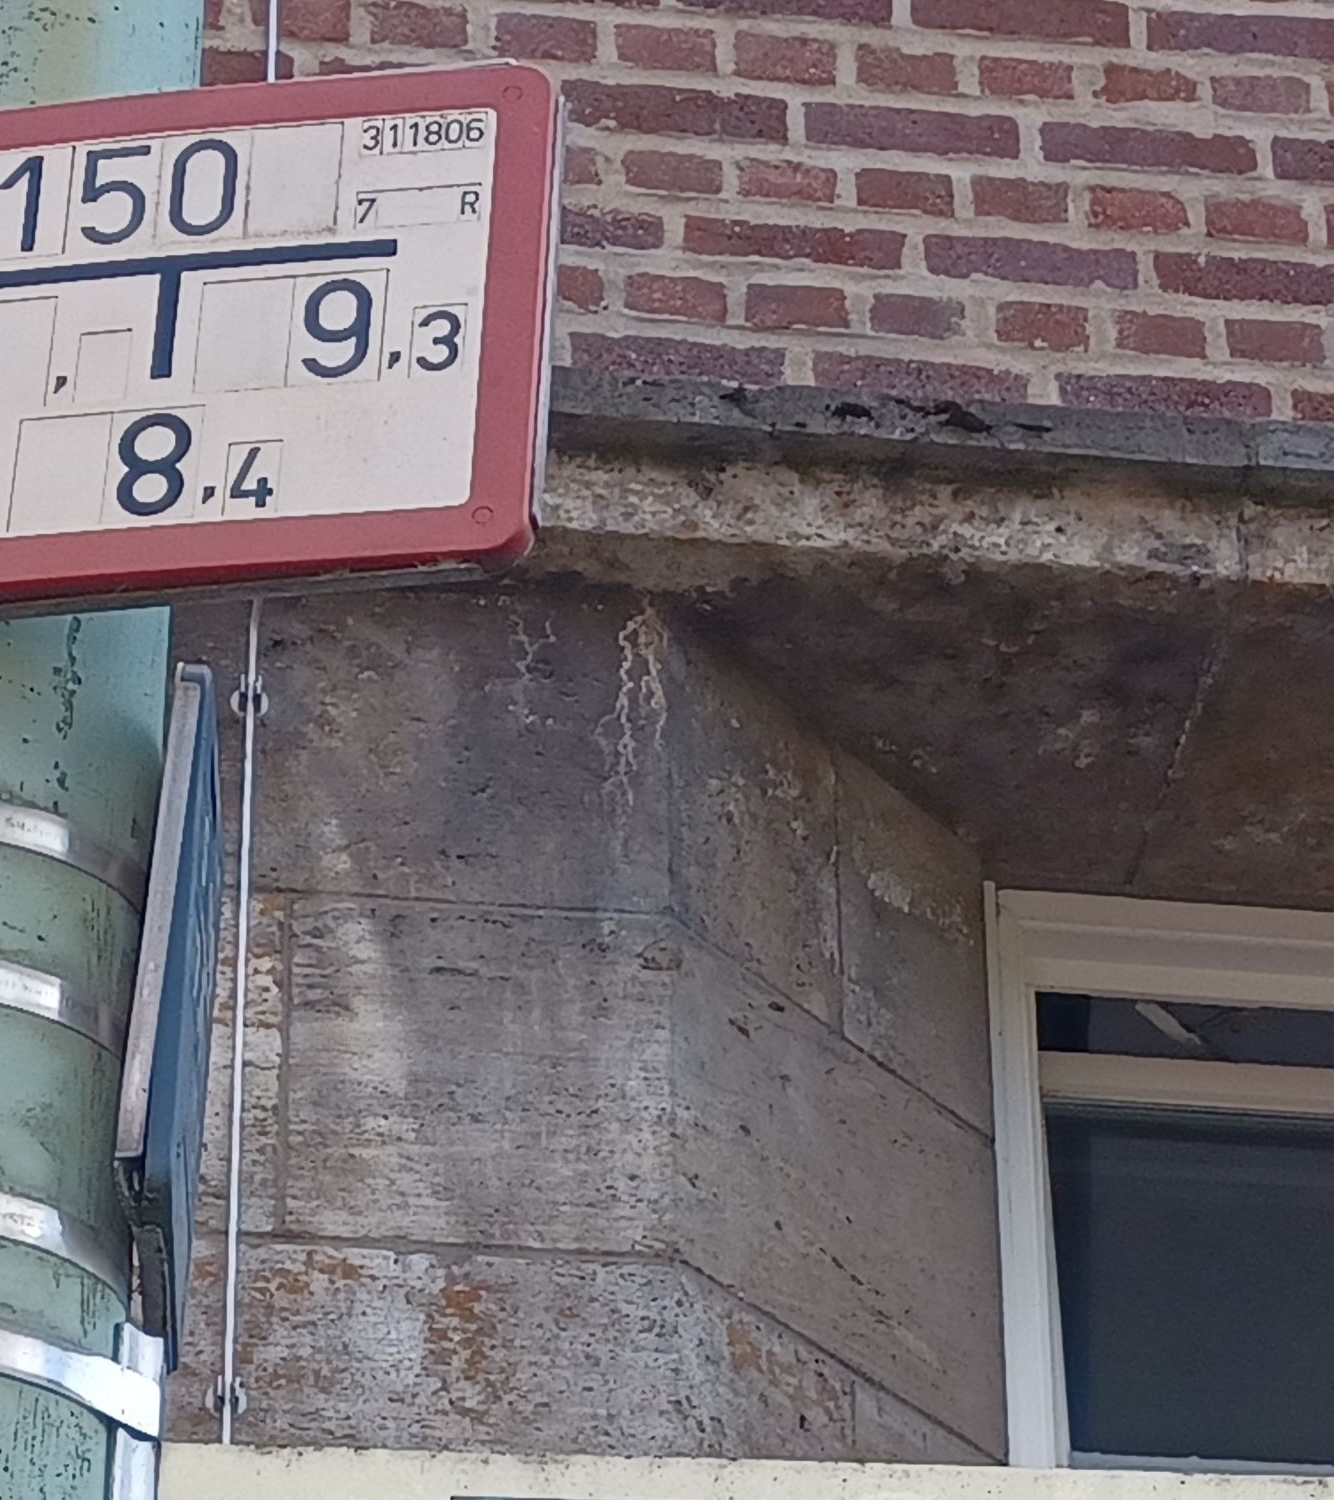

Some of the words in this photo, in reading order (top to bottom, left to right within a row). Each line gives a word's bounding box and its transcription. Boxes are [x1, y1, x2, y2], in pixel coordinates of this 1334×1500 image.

[362, 117, 485, 152] 311806
[357, 198, 377, 225] 7
[459, 190, 479, 216] R
